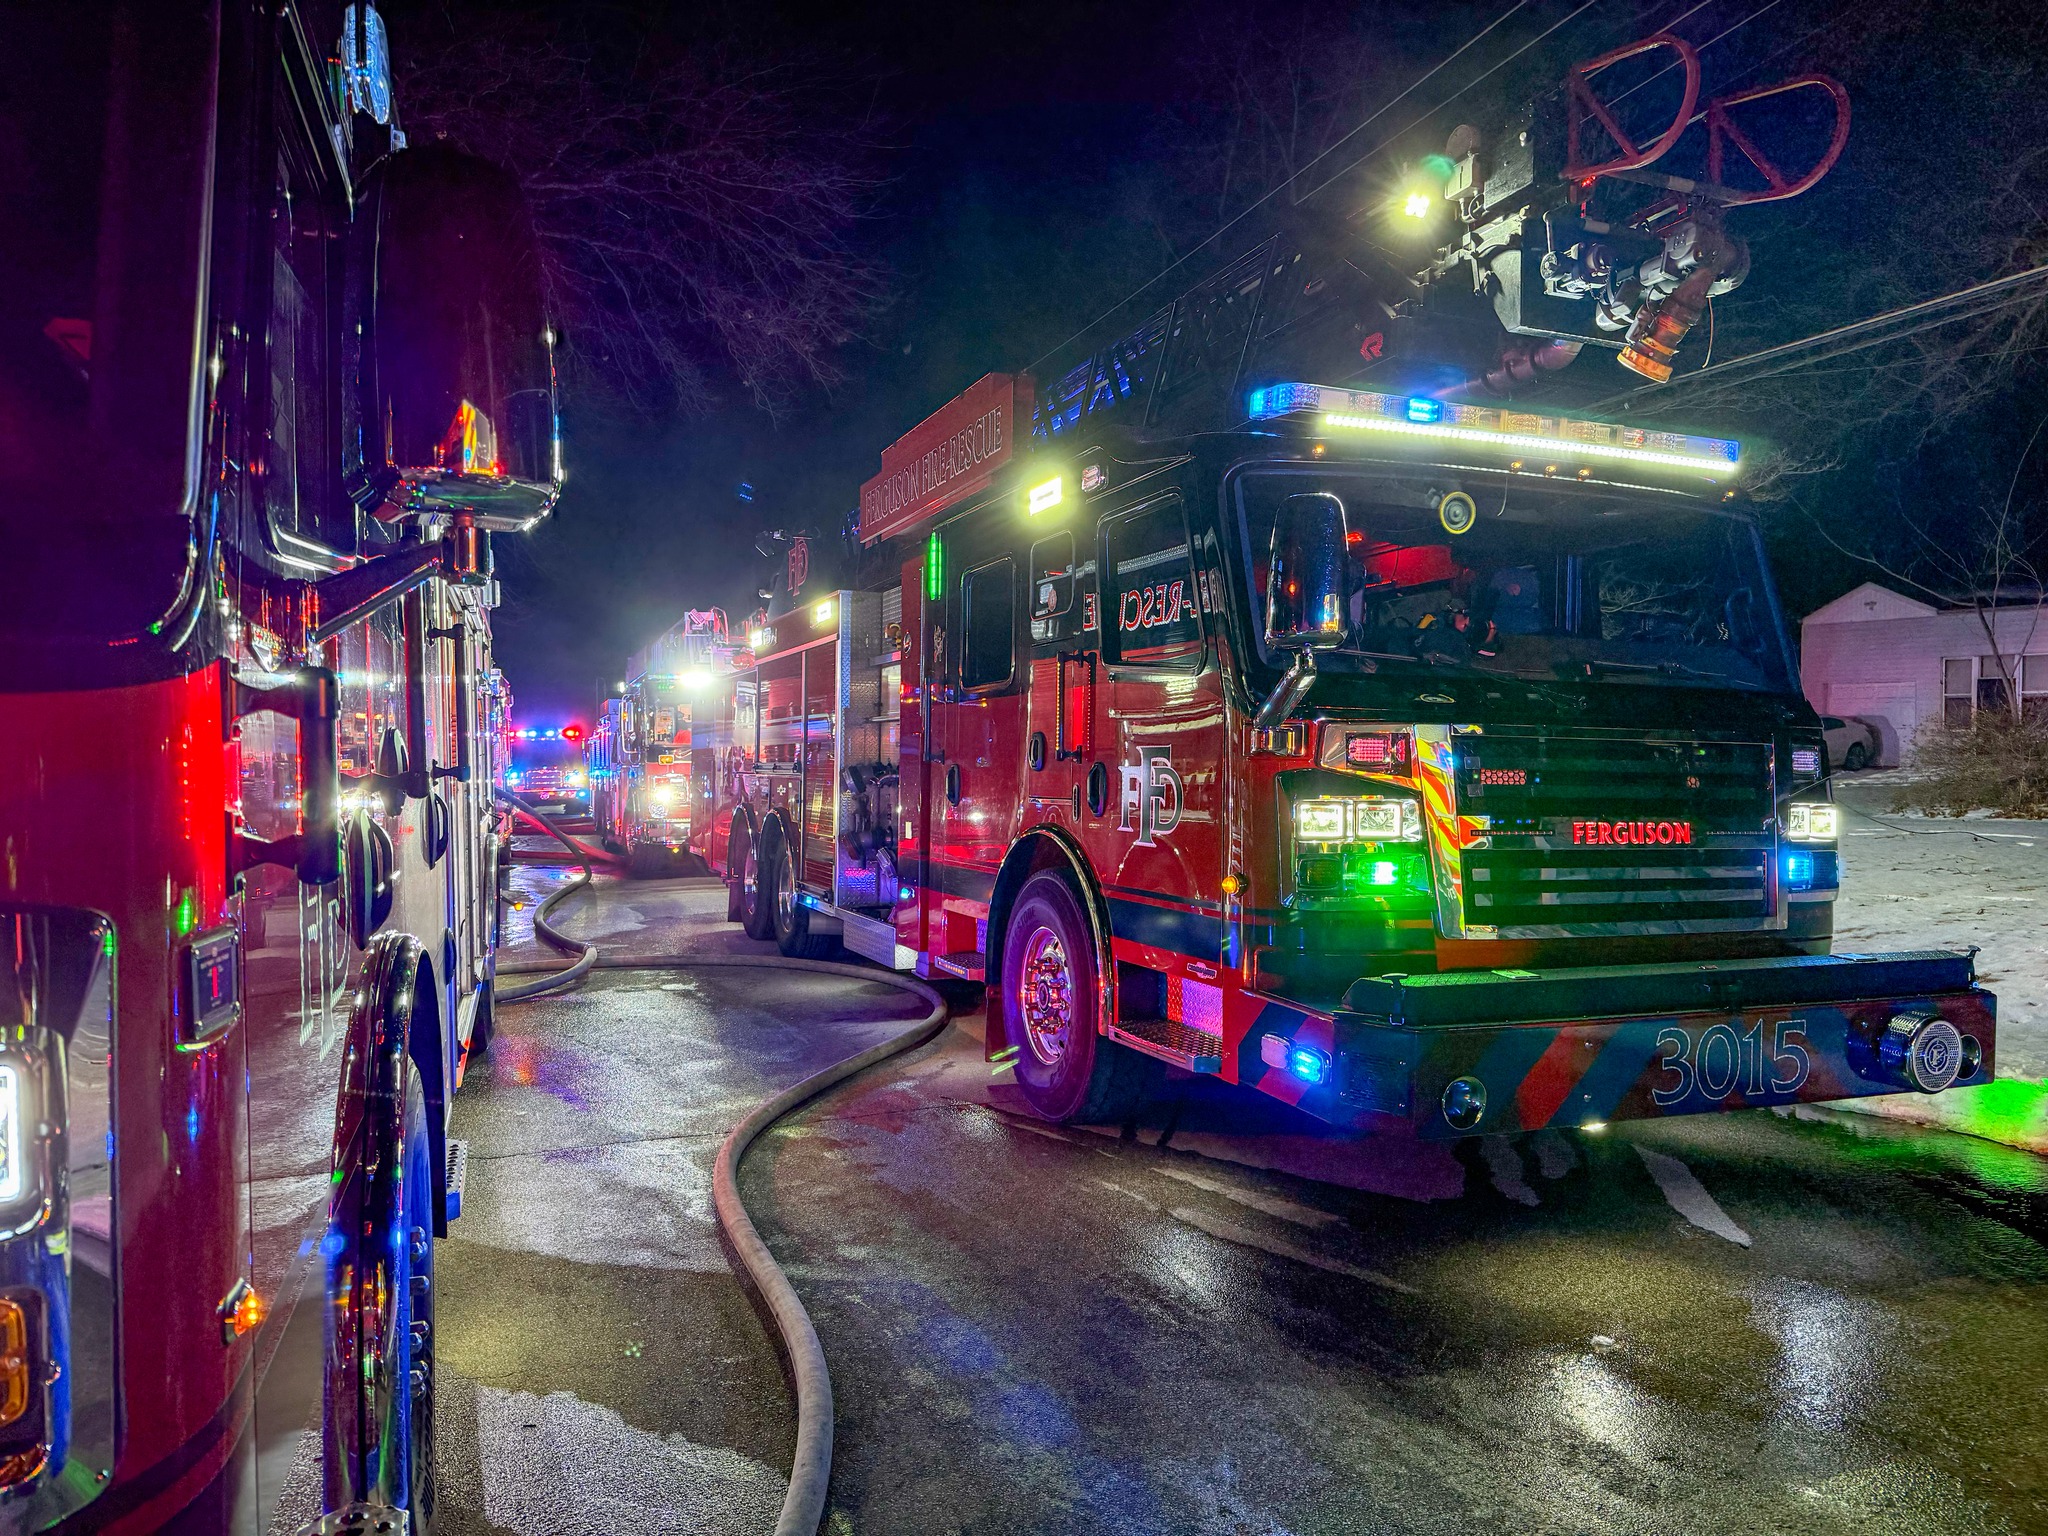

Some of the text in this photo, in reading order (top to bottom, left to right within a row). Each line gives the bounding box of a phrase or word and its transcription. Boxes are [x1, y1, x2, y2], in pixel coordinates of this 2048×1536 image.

[865, 404, 1003, 527] FERGUSON FIRE-RESCUE
[1572, 822, 1691, 845] FERGUSON
[1651, 1018, 1810, 1106] 3015
